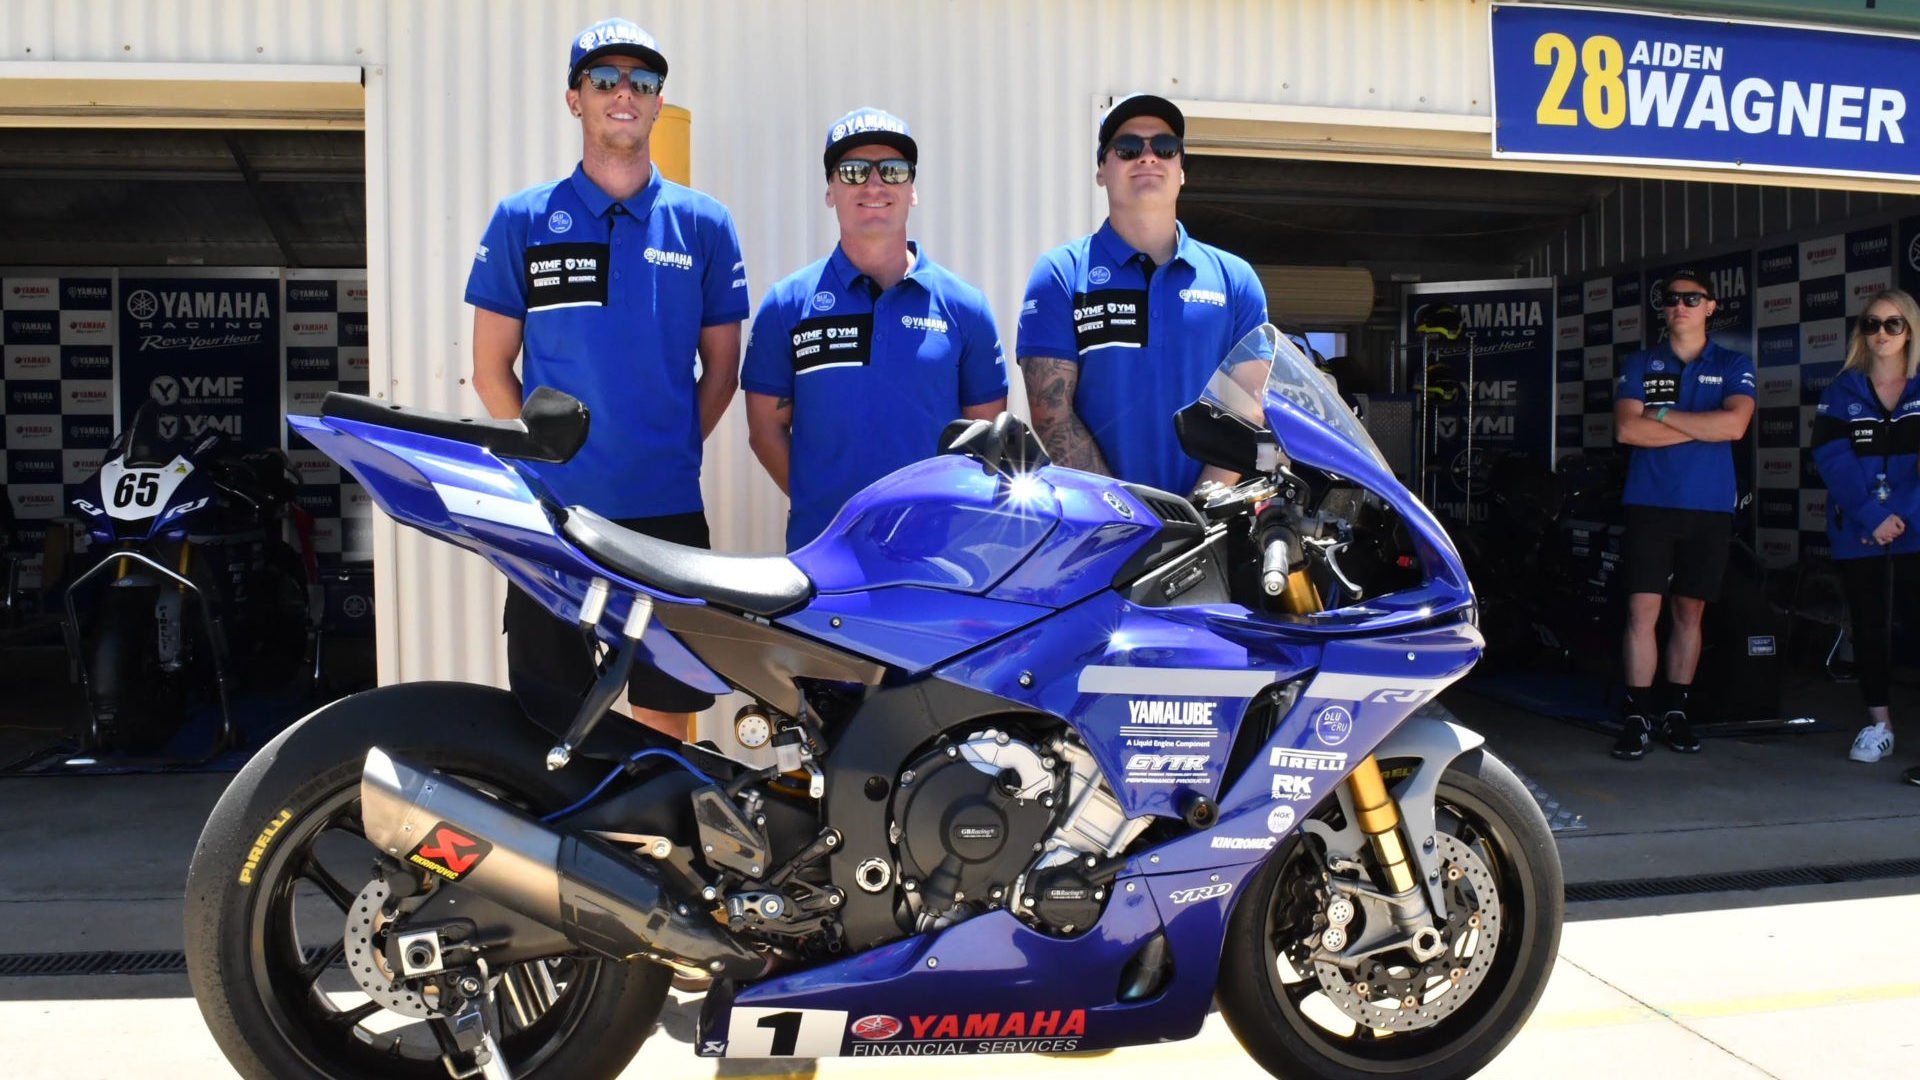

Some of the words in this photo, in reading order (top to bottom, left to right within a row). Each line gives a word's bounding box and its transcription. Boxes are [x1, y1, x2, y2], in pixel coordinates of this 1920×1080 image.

[1629, 40, 1724, 71] AIDEN
[1534, 32, 1627, 130] 28
[1627, 68, 1907, 144] WAGNER
[539, 260, 561, 270] YMF
[576, 259, 596, 267] YMI
[656, 250, 692, 267] YAMAHA
[160, 291, 271, 319] YAMAHA
[1082, 305, 1104, 315] YMF
[1117, 304, 1135, 312] YMI
[1456, 301, 1544, 328] AMAHA
[801, 329, 823, 340] YMF
[838, 327, 858, 335] YMI
[912, 317, 948, 331] YAMAHA
[139, 334, 187, 351] Revs
[188, 335, 222, 350] Your
[223, 334, 259, 344] Heart
[181, 377, 244, 397] YMF
[1460, 380, 1518, 400] YMF
[184, 415, 242, 435] YMI
[1462, 416, 1514, 435] YMI
[113, 472, 161, 508] 65
[1129, 700, 1213, 725] YAMALUBE
[1133, 739, 1152, 747] Liquid
[1154, 740, 1174, 748] Engine
[1126, 754, 1209, 771] GYTR
[1269, 747, 1348, 771] PIRELLI
[1271, 774, 1314, 794] RK
[239, 809, 293, 885] PIRELLI
[757, 1012, 803, 1056] 1
[909, 1009, 1087, 1039] YAMAHA
[852, 1042, 969, 1057] FINANCIAL
[977, 1039, 1079, 1054] SERVICES
